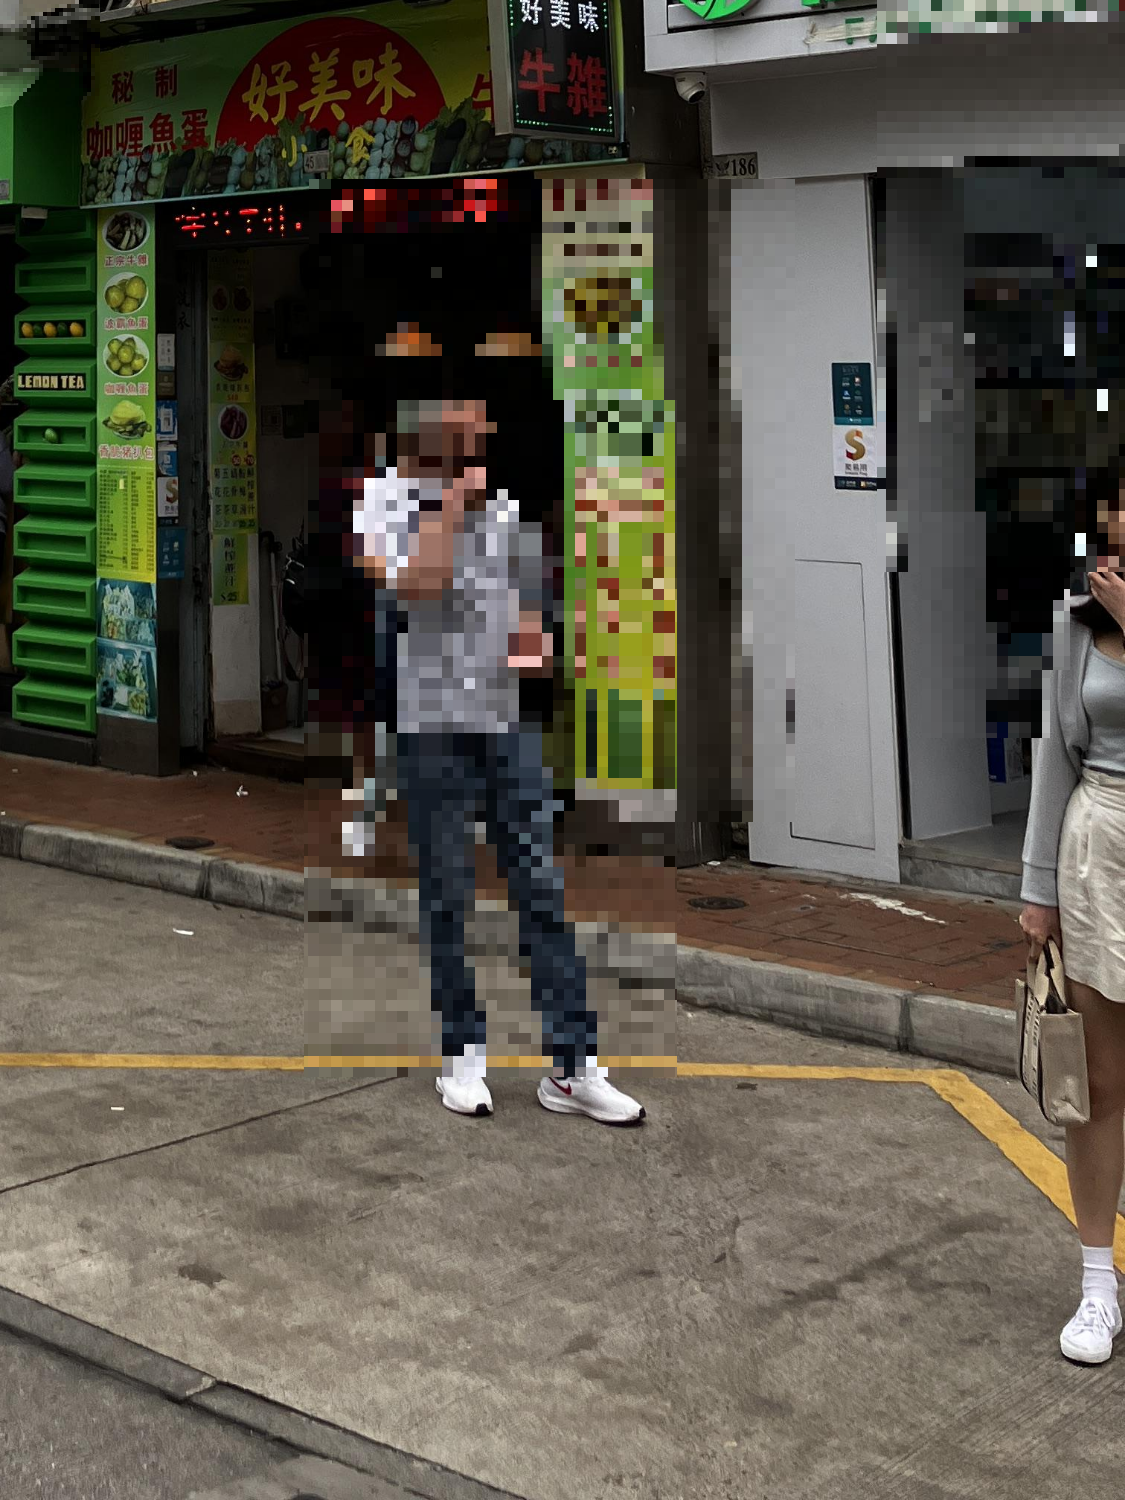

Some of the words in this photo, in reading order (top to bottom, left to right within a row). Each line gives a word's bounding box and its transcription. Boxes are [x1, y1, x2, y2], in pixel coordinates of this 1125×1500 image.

[111, 64, 178, 105] 秘制
[242, 41, 417, 126] 好美味
[731, 157, 757, 177] 186
[17, 374, 59, 389] LEMON
[60, 374, 85, 390] TEA
